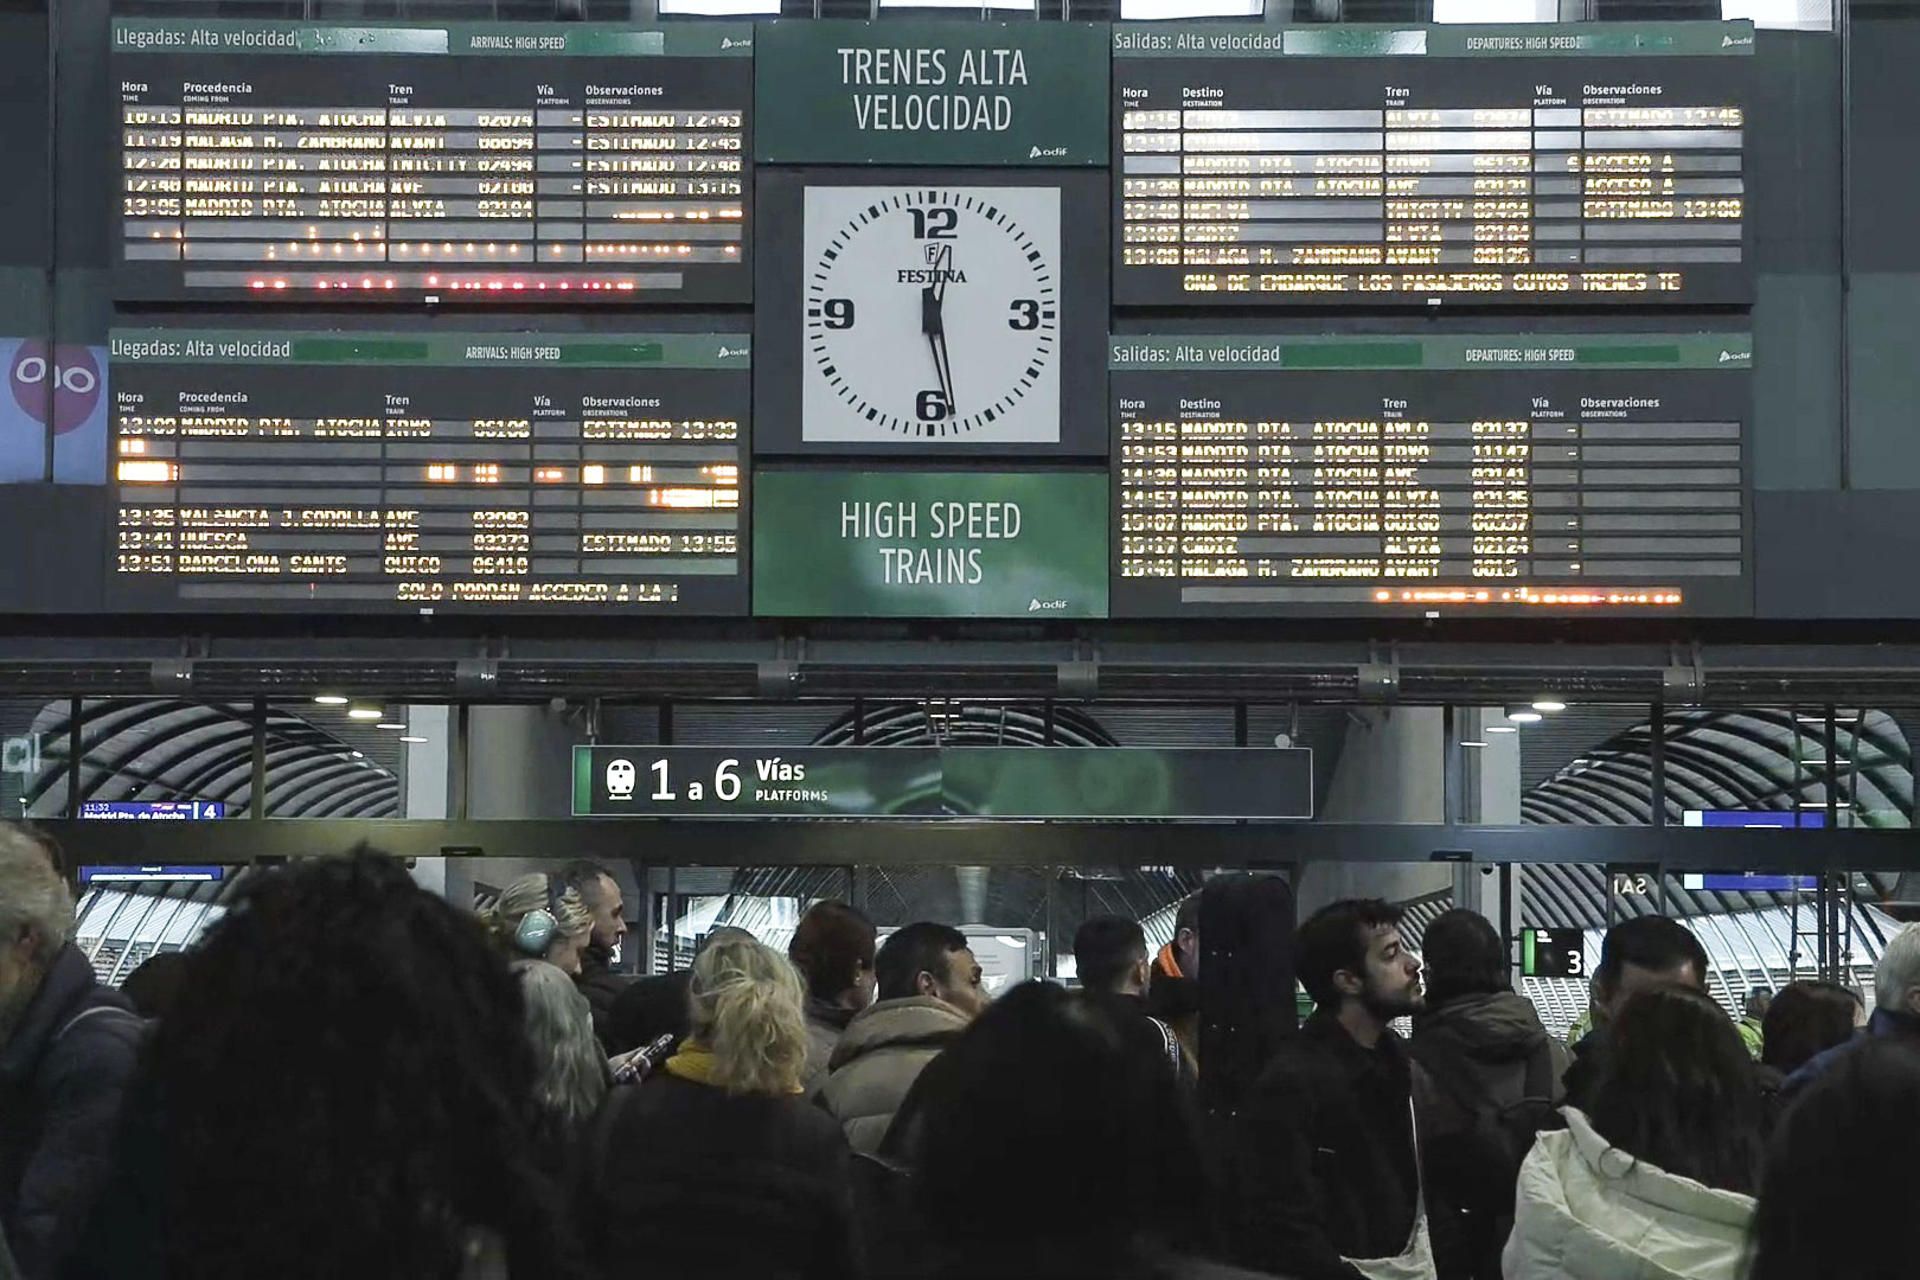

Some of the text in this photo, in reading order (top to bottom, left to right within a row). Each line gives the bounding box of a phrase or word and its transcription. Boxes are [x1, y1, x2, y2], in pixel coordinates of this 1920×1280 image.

[117, 28, 296, 49] Llegadas: Alta velocidad
[470, 36, 565, 49] ARRIVALS: HIGH SPEED
[1114, 33, 1281, 50] Salidas: Alta velocidad
[1466, 37, 1576, 49] DEPARTURES: HIGH SPEED
[837, 48, 1028, 85] TRENES ALTA
[122, 82, 148, 92] Hora
[183, 82, 252, 93] Procedencia
[389, 84, 413, 95] Tren
[537, 84, 554, 96] Vía
[585, 84, 663, 96] Observaciones
[1122, 87, 1148, 98] Hora
[1182, 87, 1224, 98] Destino
[1385, 87, 1410, 97] Tren
[1535, 84, 1553, 96] Vía
[1583, 84, 1662, 97] Observaciones
[853, 94, 1013, 131] VELOCIDAD
[1042, 146, 1068, 157] adif
[906, 208, 958, 239] 12
[897, 269, 967, 283] FESTINA
[824, 298, 855, 329] 9
[1008, 299, 1040, 330] 3
[111, 339, 290, 360] Llegadas: Alta velocidad
[466, 346, 561, 360] ARRIVALS: HIGH SPEED
[1113, 345, 1280, 363] Salidas: Alta velocidad
[1466, 349, 1575, 362] DEPARTURES: HIGH SPEED
[118, 392, 144, 403] Hora
[179, 392, 248, 404] Procedencia
[385, 395, 410, 405] Tren
[534, 396, 551, 407] Vía
[582, 396, 660, 407] Observaciones
[1119, 398, 1145, 409] Hora
[1383, 398, 1407, 409] Tren
[1532, 397, 1549, 408] Vía
[1580, 397, 1660, 408] Observaciones
[916, 390, 947, 421] 6
[1180, 398, 1221, 410] Destino
[841, 502, 1021, 539] HIGH SPEED
[879, 548, 983, 584] TRAINS
[756, 757, 804, 781] Vías
[650, 758, 741, 801] 1 a 6
[756, 790, 828, 801] PLATFORMS
[203, 804, 216, 819] 4
[1567, 950, 1582, 974] 3
